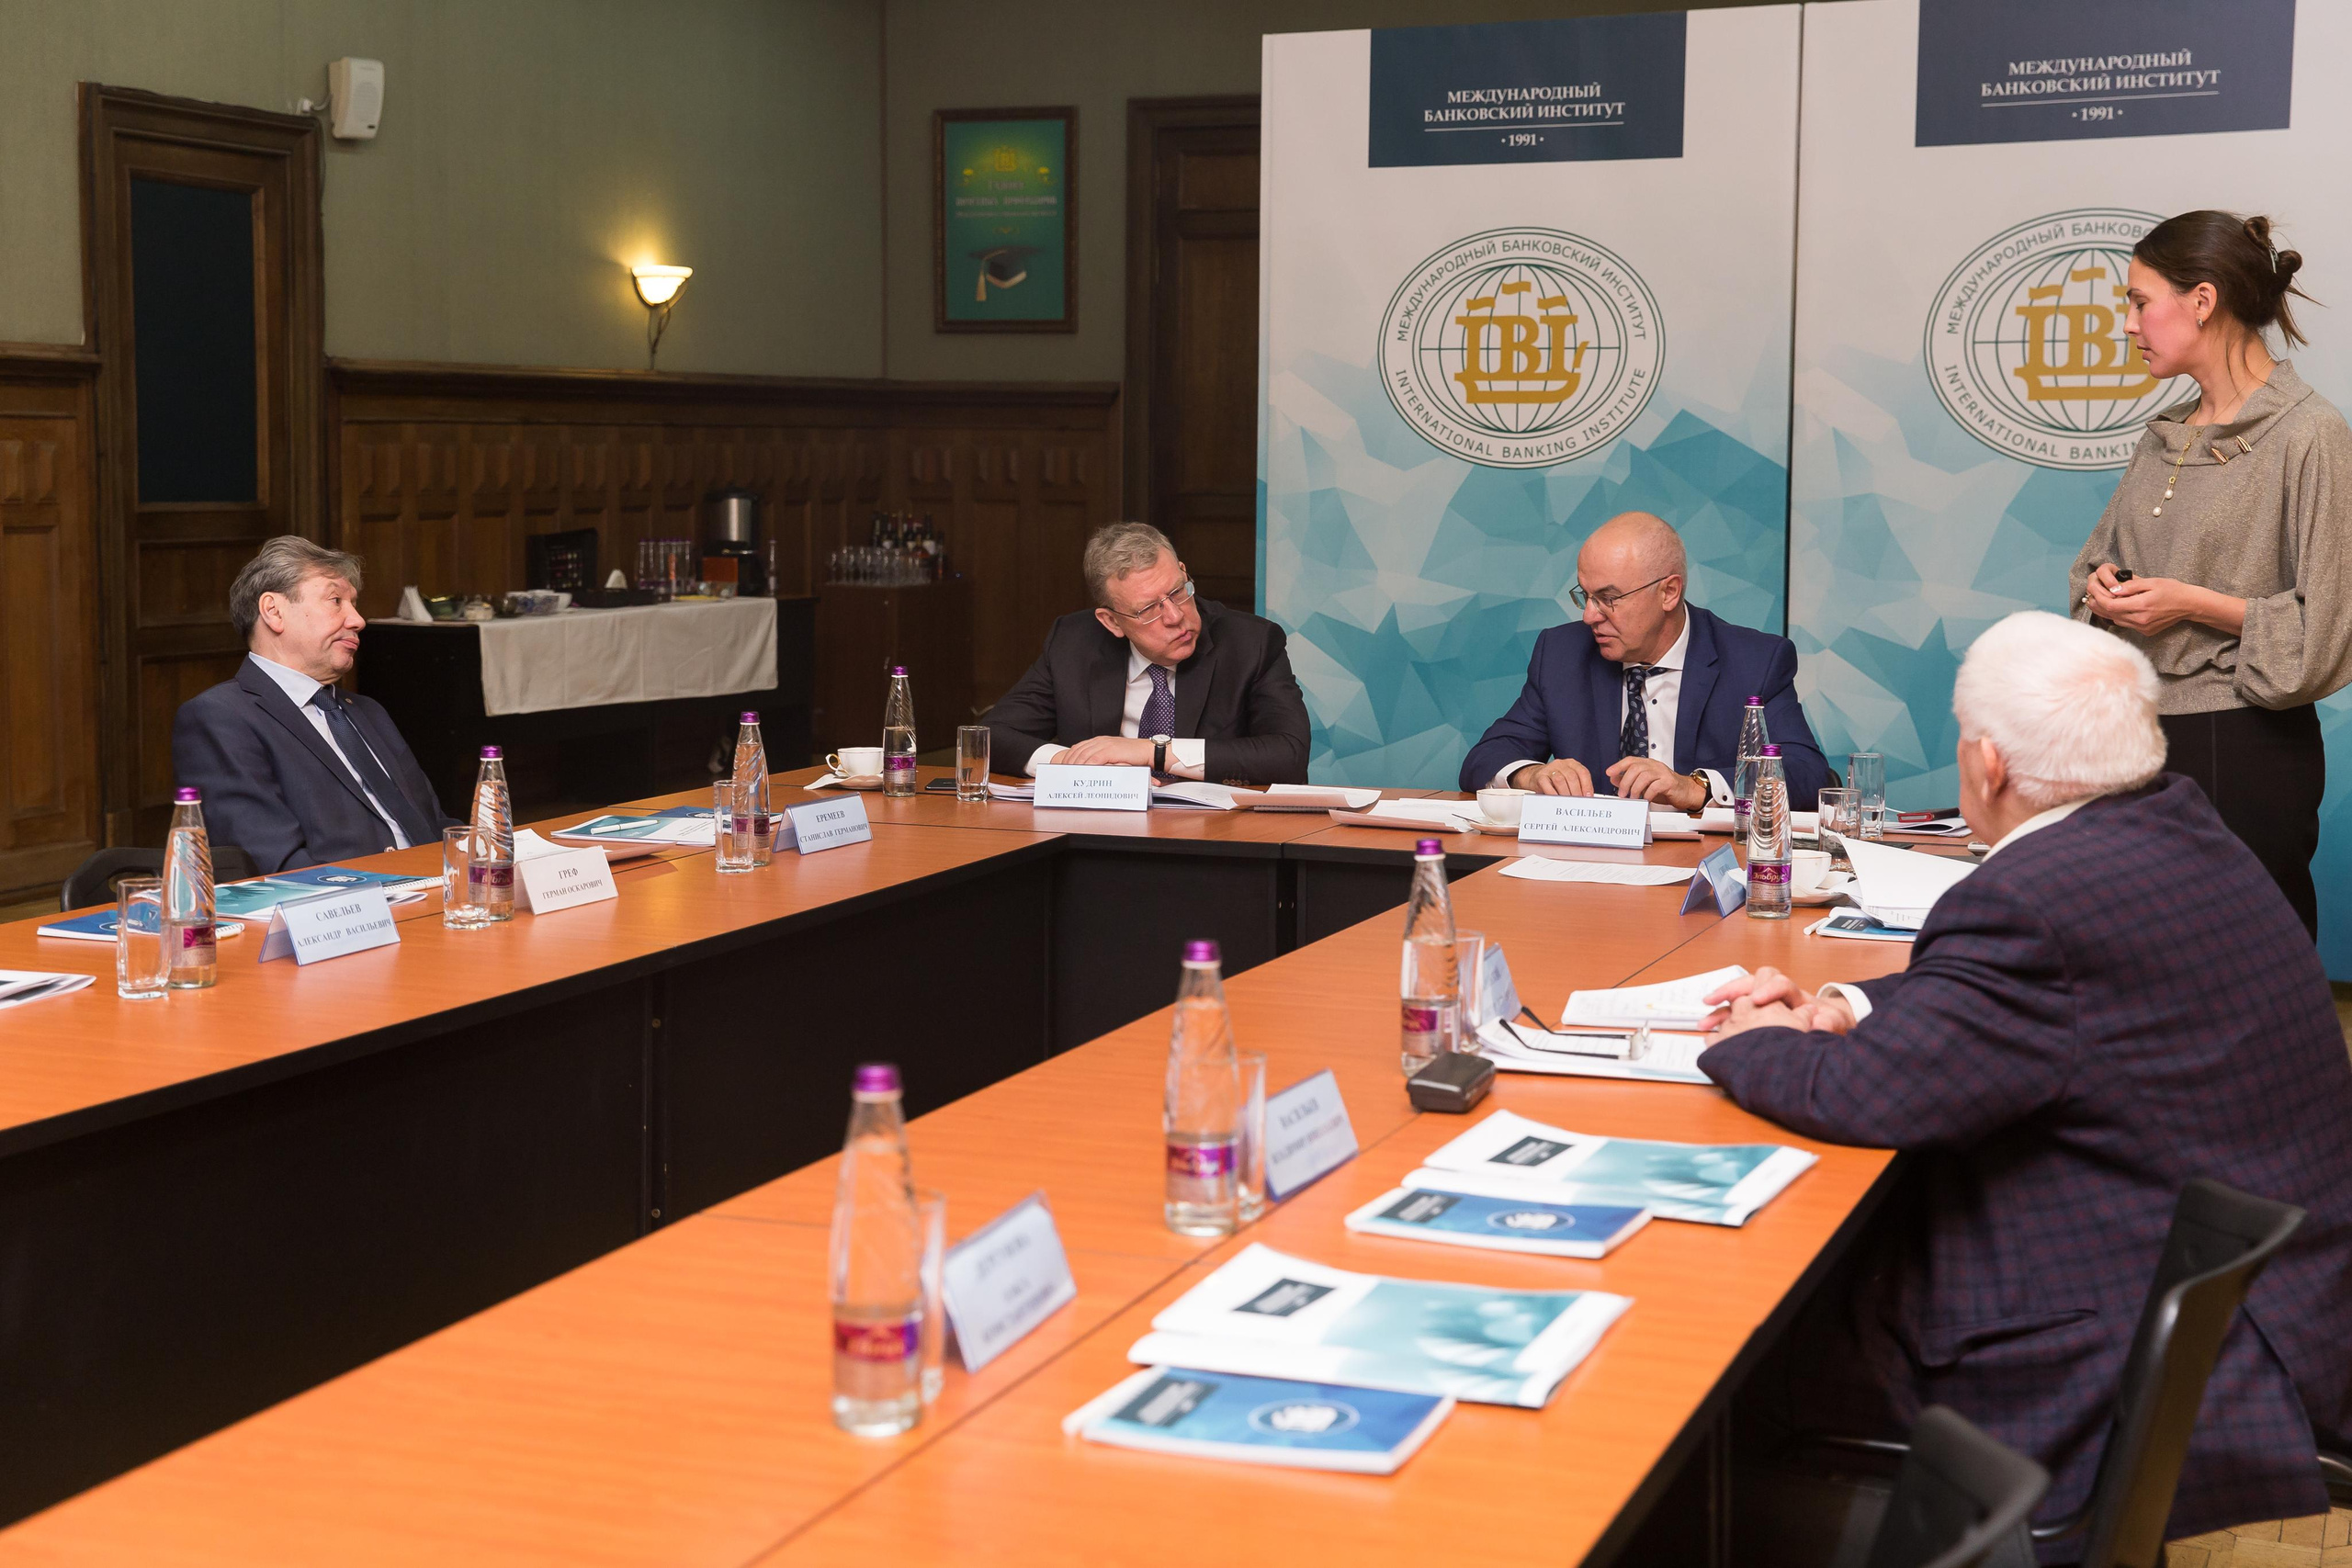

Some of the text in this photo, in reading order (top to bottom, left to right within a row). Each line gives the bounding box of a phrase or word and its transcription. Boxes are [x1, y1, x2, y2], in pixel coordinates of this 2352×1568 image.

[2008, 48, 2192, 76] МЕЖДУНАРОДНЫЙ
[1981, 69, 2222, 97] БАНКОВСКИЙ ИНСТИТУТ
[1447, 82, 1601, 105] МЕЖДУНАРОДНЫЙ
[1424, 102, 1625, 122] БАНКОВСКИЙ ИНСТИТУТ
[1947, 222, 2065, 334] МЕЖДУНАРОДНЫЙ
[1397, 240, 1645, 341] МЕЖДУНАРОДНЫЙ БАНКОВСКИЙ ИНСТИТУТ
[1396, 367, 1646, 458] INTERNATIONAL BANKING INSTITUTE
[1945, 365, 2059, 457] INTERNATIONAL
[1073, 780, 1113, 788] КУДРИН
[816, 811, 845, 823] ЕРЕМЕЕВ
[1555, 807, 1612, 818] ВАСИЛЬЕВ
[799, 823, 868, 843] СТАНИСЛАВ ГЕРМАНОВИЧ
[1524, 822, 1640, 836] СЕРГЕЙ АЛЕКСАНДРОВИЧ
[559, 868, 579, 879] ГРЕФ
[542, 879, 603, 899] ГЕРМАН ОСКАРОВИЧ
[315, 903, 362, 921] САВЕЛЬЕВ
[298, 919, 392, 948] АЛЕКСАНДР ВАСИЛЬЕВИЧ
